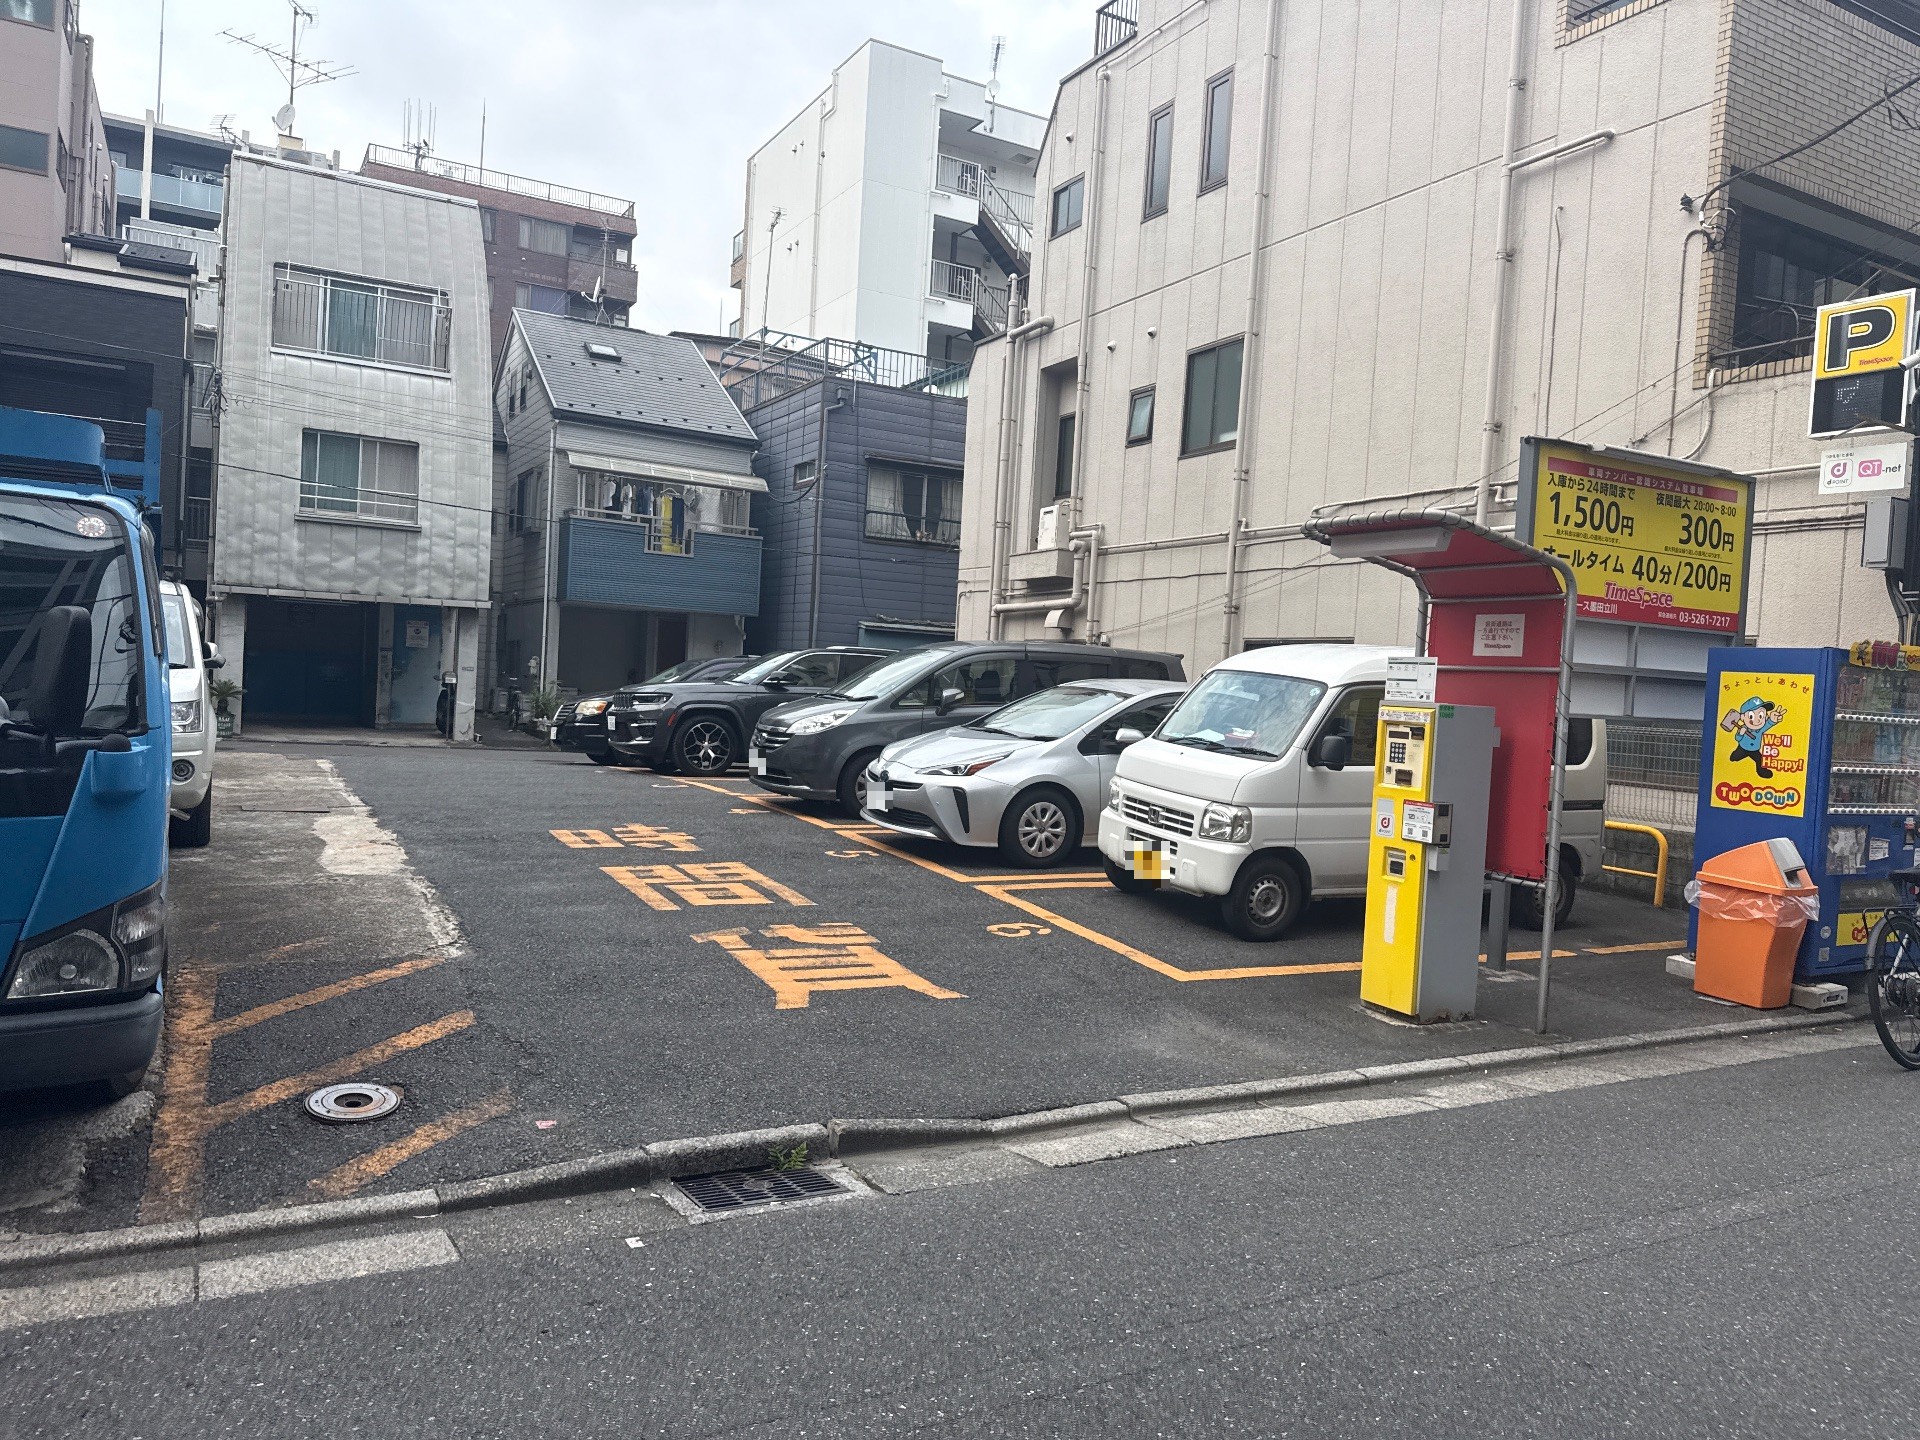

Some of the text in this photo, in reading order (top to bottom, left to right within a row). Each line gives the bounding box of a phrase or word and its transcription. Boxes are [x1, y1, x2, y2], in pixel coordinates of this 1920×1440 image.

[1824, 305, 1897, 372] P
[1547, 473, 1636, 500] 入庫から24時間まで
[1549, 491, 1635, 537] 1,500円
[1678, 512, 1735, 552] 300円
[1605, 581, 1674, 609] TimeSpace
[1679, 611, 1731, 627] 03-5261-7217
[1763, 734, 1791, 747] We'll
[1763, 745, 1779, 756] Be
[1762, 757, 1804, 772] Happy!
